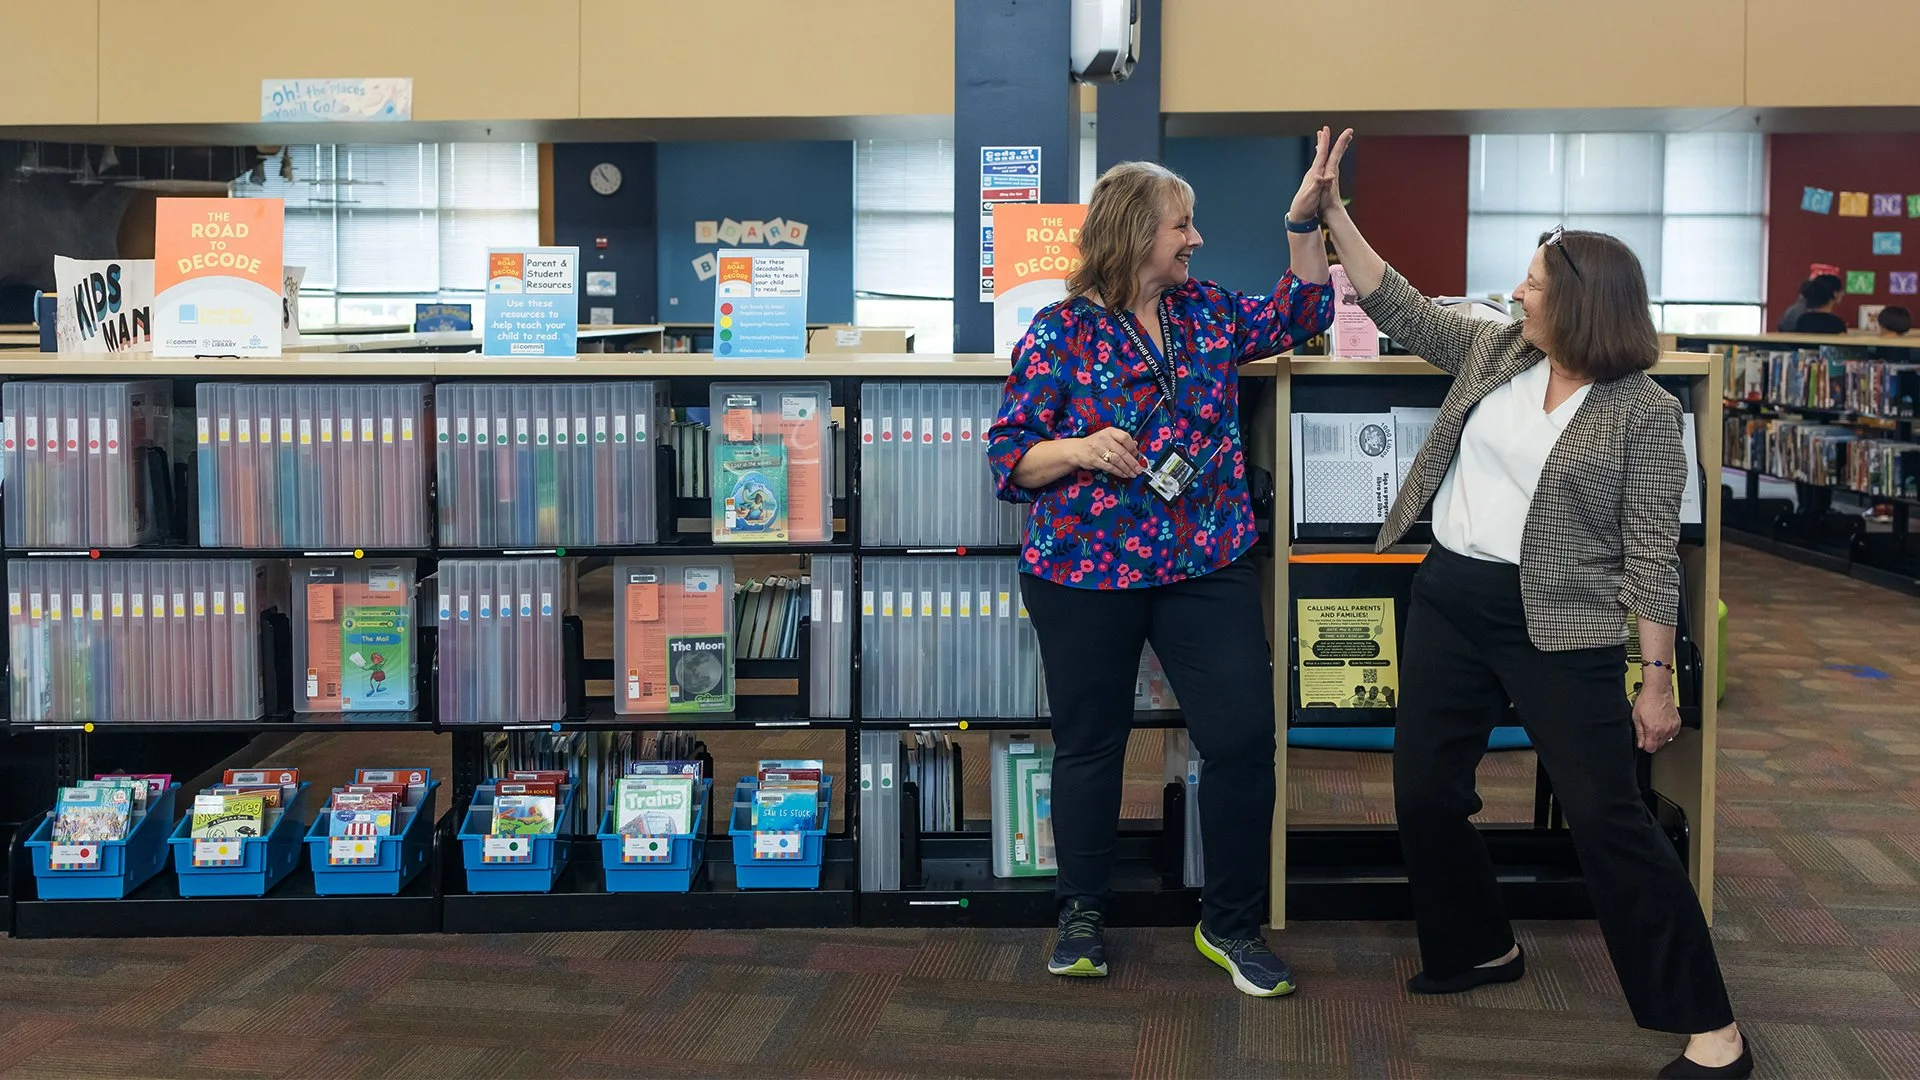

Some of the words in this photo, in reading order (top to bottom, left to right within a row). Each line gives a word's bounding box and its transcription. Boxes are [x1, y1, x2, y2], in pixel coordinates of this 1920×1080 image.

[208, 212, 230, 222] THE
[1040, 218, 1063, 226] THE
[191, 223, 249, 238] ROAD
[701, 226, 801, 239] BOARD
[1026, 228, 1080, 242] ROAD
[210, 241, 226, 250] TO
[1044, 246, 1060, 254] TO
[177, 252, 262, 274] DECODE
[527, 259, 556, 268] Parent
[1014, 256, 1082, 278] DECOD
[526, 280, 572, 289] Resources
[74, 264, 122, 341] KIDS
[528, 299, 553, 307] these
[102, 306, 150, 352] MAN
[493, 321, 512, 330] help
[516, 321, 541, 329] teach
[546, 322, 566, 330] your
[497, 332, 519, 340] child
[1122, 321, 1149, 356] BRASHEAR
[1162, 324, 1176, 370] ELEMENTARY
[1145, 354, 1162, 377] TYLER
[1380, 438, 1392, 458] Libros
[671, 642, 691, 651] The
[696, 642, 725, 650] Moon
[625, 792, 682, 810] Trains
[232, 802, 262, 816] Greg
[790, 809, 811, 817] STUCK
